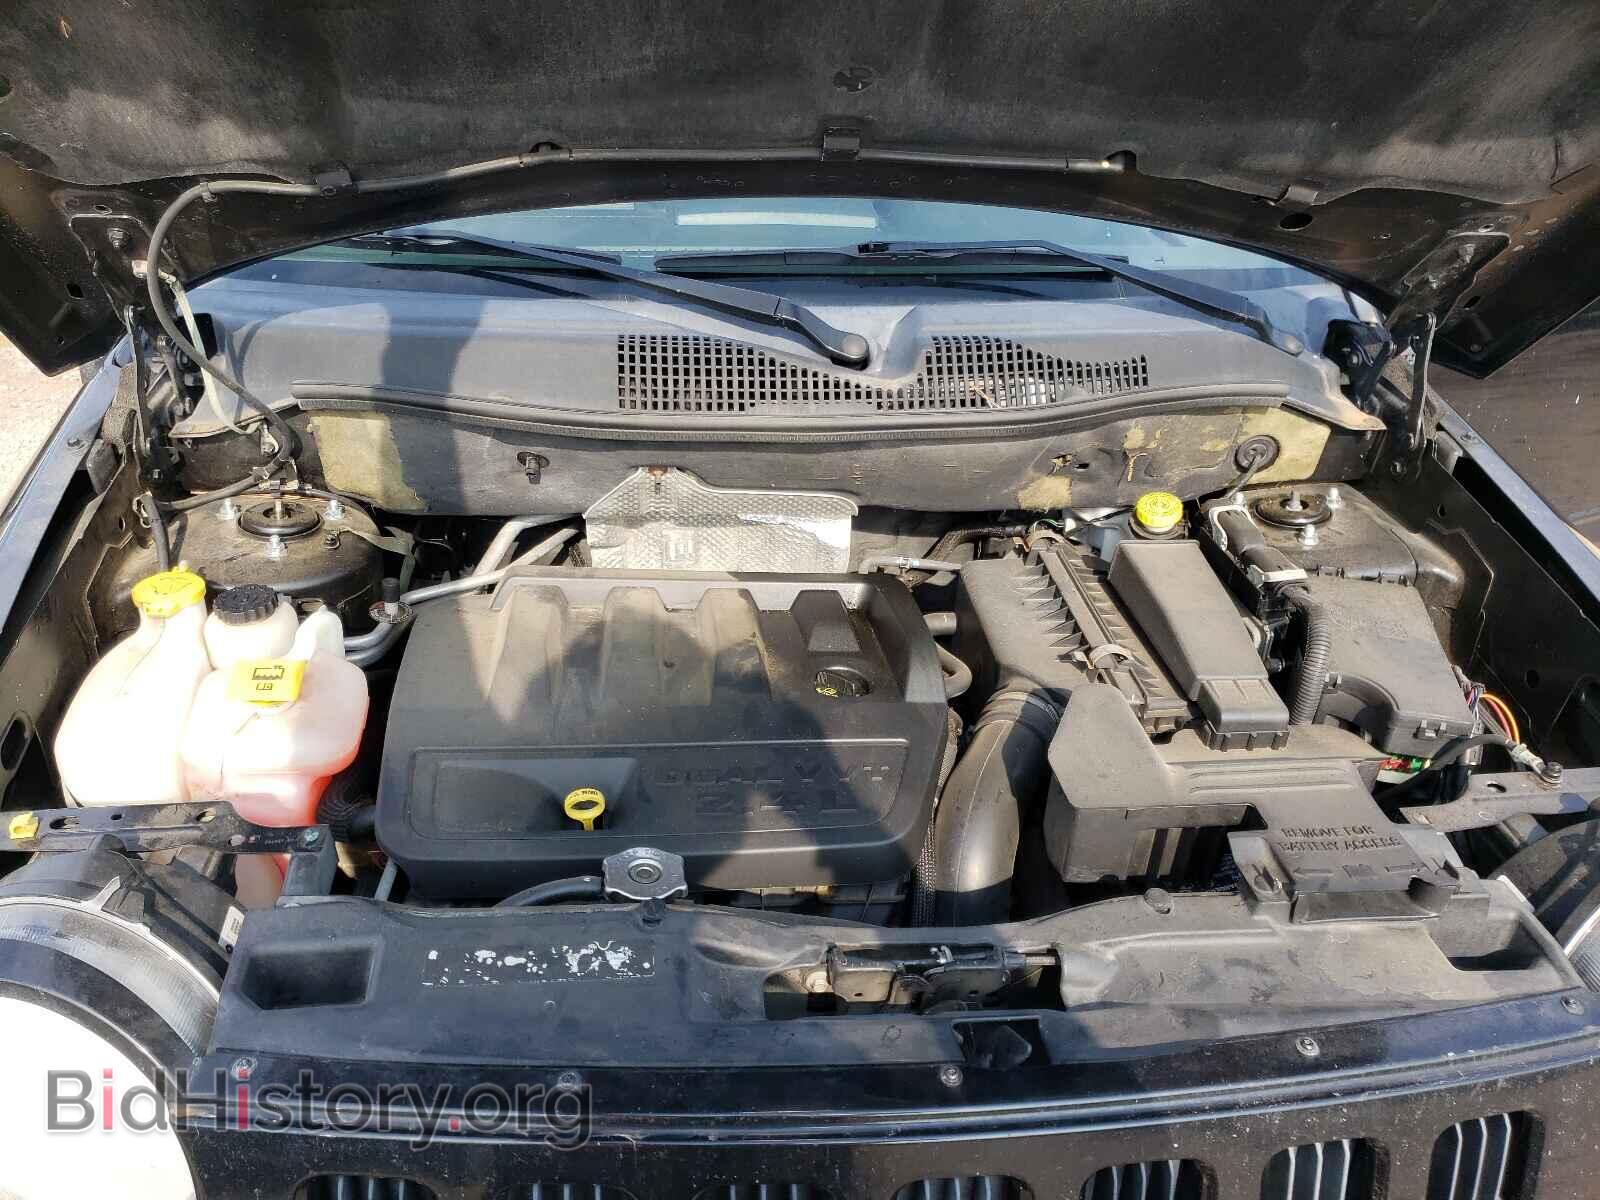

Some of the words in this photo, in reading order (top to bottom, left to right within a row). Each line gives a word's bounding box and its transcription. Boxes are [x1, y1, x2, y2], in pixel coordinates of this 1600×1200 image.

[1281, 827, 1340, 838] REMOVE
[1343, 824, 1375, 836] FOR
[1279, 841, 1339, 851] BATTERY
[1344, 837, 1401, 850] ACCESS
